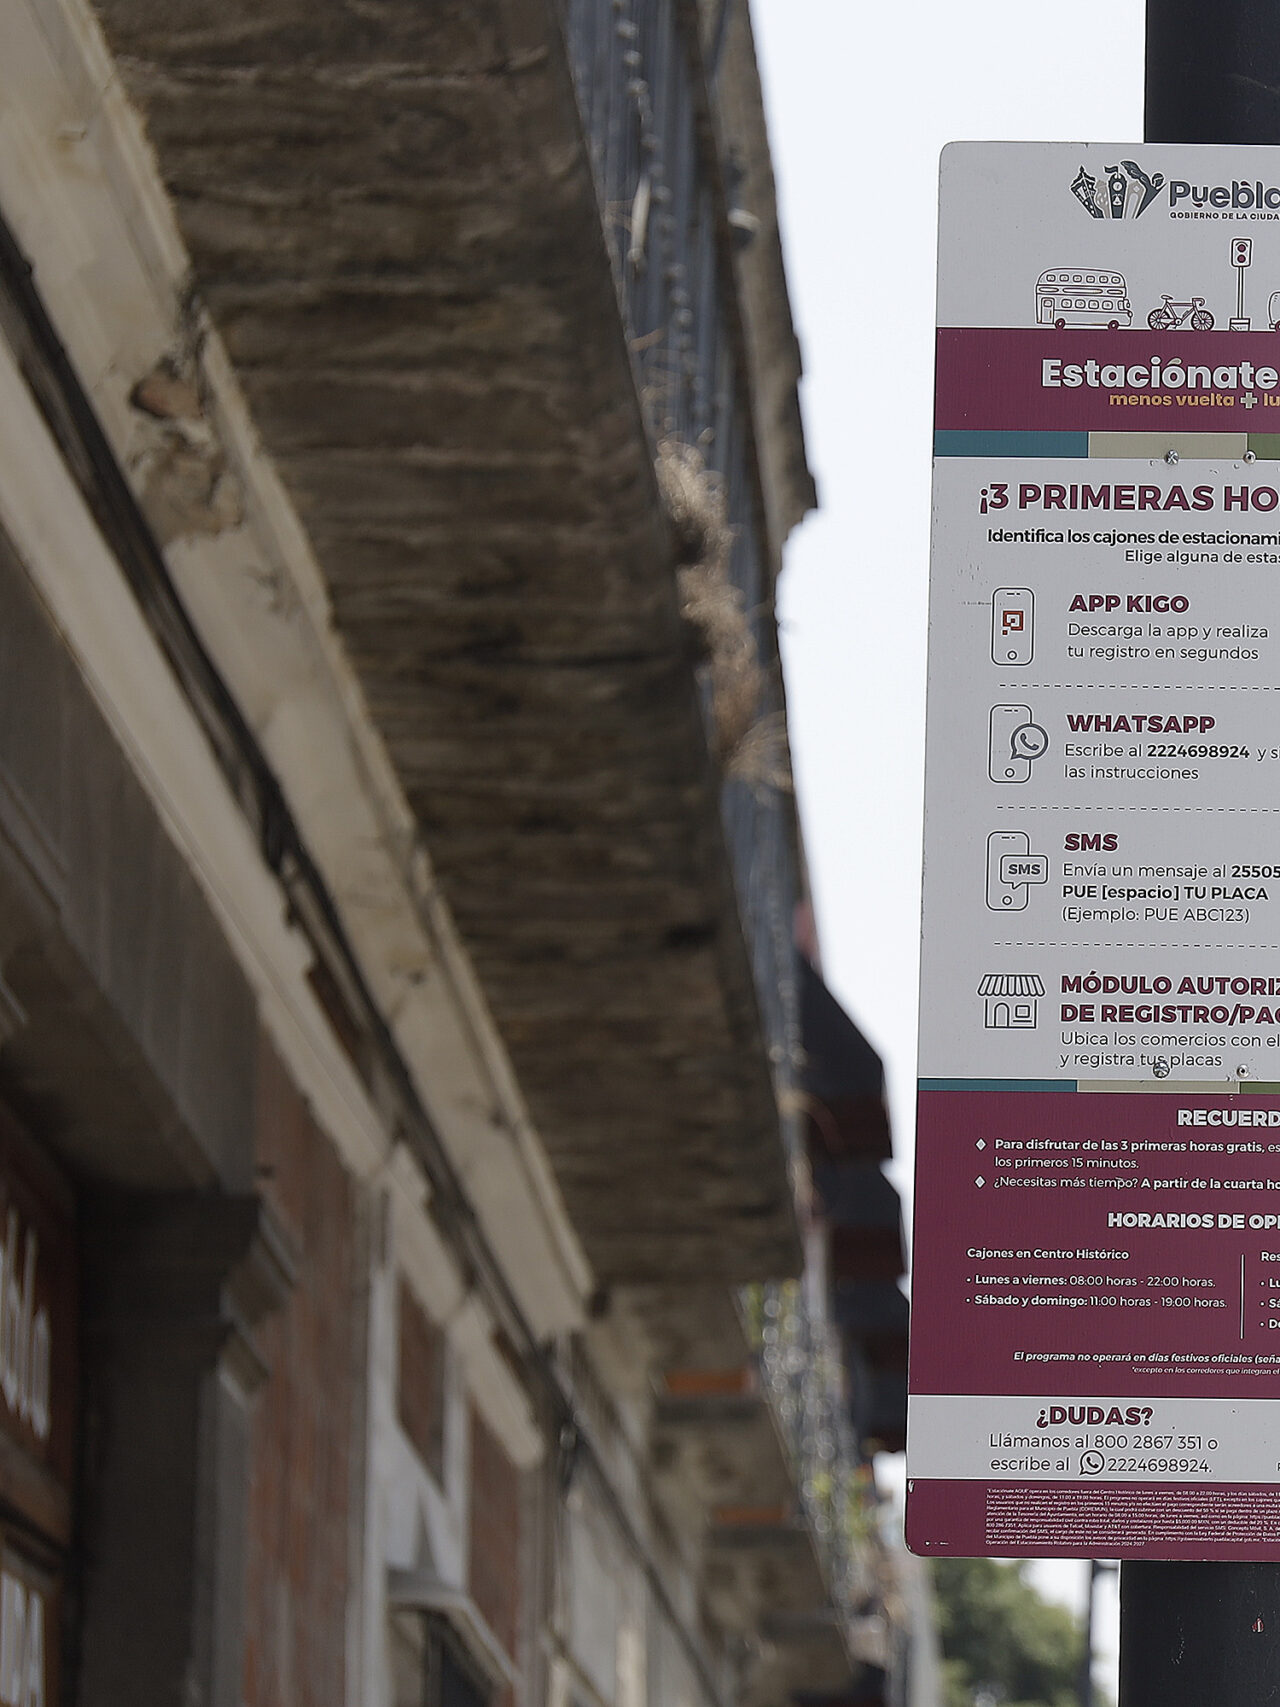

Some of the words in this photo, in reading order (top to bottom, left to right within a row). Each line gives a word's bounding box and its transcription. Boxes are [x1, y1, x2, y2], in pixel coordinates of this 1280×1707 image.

[1110, 395, 1171, 405] menos
[1176, 393, 1234, 406] vuelta
[980, 483, 1008, 513] ¡3
[1018, 484, 1214, 510] PRIMERAS
[988, 528, 1063, 542] Identifica
[1068, 529, 1090, 542] los
[1093, 529, 1155, 546] cajones
[1158, 530, 1179, 544] de
[1068, 594, 1120, 612] APP
[1126, 595, 1189, 612] KIGO
[1066, 714, 1215, 732] WHATSAPP
[1065, 743, 1123, 756] Escribe
[1128, 744, 1141, 756] al
[1147, 744, 1249, 757] 2224698924
[1257, 749, 1266, 761] y
[1065, 764, 1085, 778] las
[1091, 765, 1198, 779] instrucciones
[1064, 833, 1118, 851] SMS
[1008, 864, 1040, 874] SMS
[1064, 863, 1106, 876] Envía
[1112, 866, 1132, 876] un
[1138, 864, 1207, 880] mensaje
[1212, 864, 1225, 877] al
[1063, 885, 1097, 897] PUE
[1102, 885, 1178, 900] [espacio]
[1183, 886, 1206, 899] TU
[1211, 887, 1268, 899] PLACA
[1062, 906, 1138, 922] (Ejemplo:
[1144, 907, 1178, 920] PUE
[1183, 908, 1249, 923] ABC123)
[1061, 971, 1172, 993] MÓDULO
[1060, 1004, 1094, 1022] DE
[995, 1139, 1022, 1149] Para
[1026, 1139, 1080, 1149] disfrutar
[1082, 1139, 1098, 1149] de
[1101, 1140, 1118, 1150] las
[1120, 1140, 1128, 1150] 3
[1131, 1140, 1186, 1152] primeras
[1190, 1141, 1223, 1151] horas
[1226, 1141, 1264, 1153] gratis,
[1268, 1144, 1280, 1152] es
[995, 1156, 1011, 1166] los
[1015, 1157, 1068, 1168] primeros
[1071, 1157, 1083, 1167] 15
[1086, 1158, 1138, 1168] minutos.
[1108, 1213, 1214, 1227] HORARIOS
[1218, 1214, 1244, 1228] DE
[967, 1247, 1013, 1259] Cajones
[1016, 1250, 1030, 1258] en
[1033, 1249, 1073, 1258] Centro
[1076, 1249, 1129, 1259] Histórico
[975, 1274, 1010, 1284] Lunes
[1012, 1276, 1019, 1284] a
[1022, 1274, 1067, 1284] viernes:
[1069, 1275, 1102, 1285] 08:00
[1106, 1276, 1137, 1285] horas
[1147, 1276, 1178, 1286] 22:00
[1182, 1277, 1215, 1286] horas.
[974, 1294, 1019, 1304] Sábado
[1021, 1297, 1028, 1307] y
[1031, 1295, 1087, 1307] domingo:
[1090, 1296, 1116, 1305] 11:00
[1120, 1296, 1150, 1306] horas
[1161, 1297, 1190, 1306] 19:00
[1194, 1297, 1227, 1307] horas.
[1014, 1351, 1024, 1360] El
[1025, 1353, 1075, 1361] programa
[1092, 1353, 1131, 1362] operará
[1148, 1353, 1169, 1361] días
[1171, 1353, 1209, 1362] festivos
[1211, 1354, 1252, 1362] oficiales
[1036, 1406, 1153, 1427] ¿DUDAS?
[990, 1433, 1069, 1447] Llámanos
[1074, 1434, 1088, 1448] al
[1095, 1435, 1127, 1448] 800
[1133, 1435, 1173, 1448] 2867
[1177, 1436, 1201, 1449] 351
[1208, 1439, 1217, 1449] o
[990, 1456, 1050, 1470] escribe
[1055, 1456, 1069, 1470] al
[1108, 1458, 1211, 1472] 2224698924.
